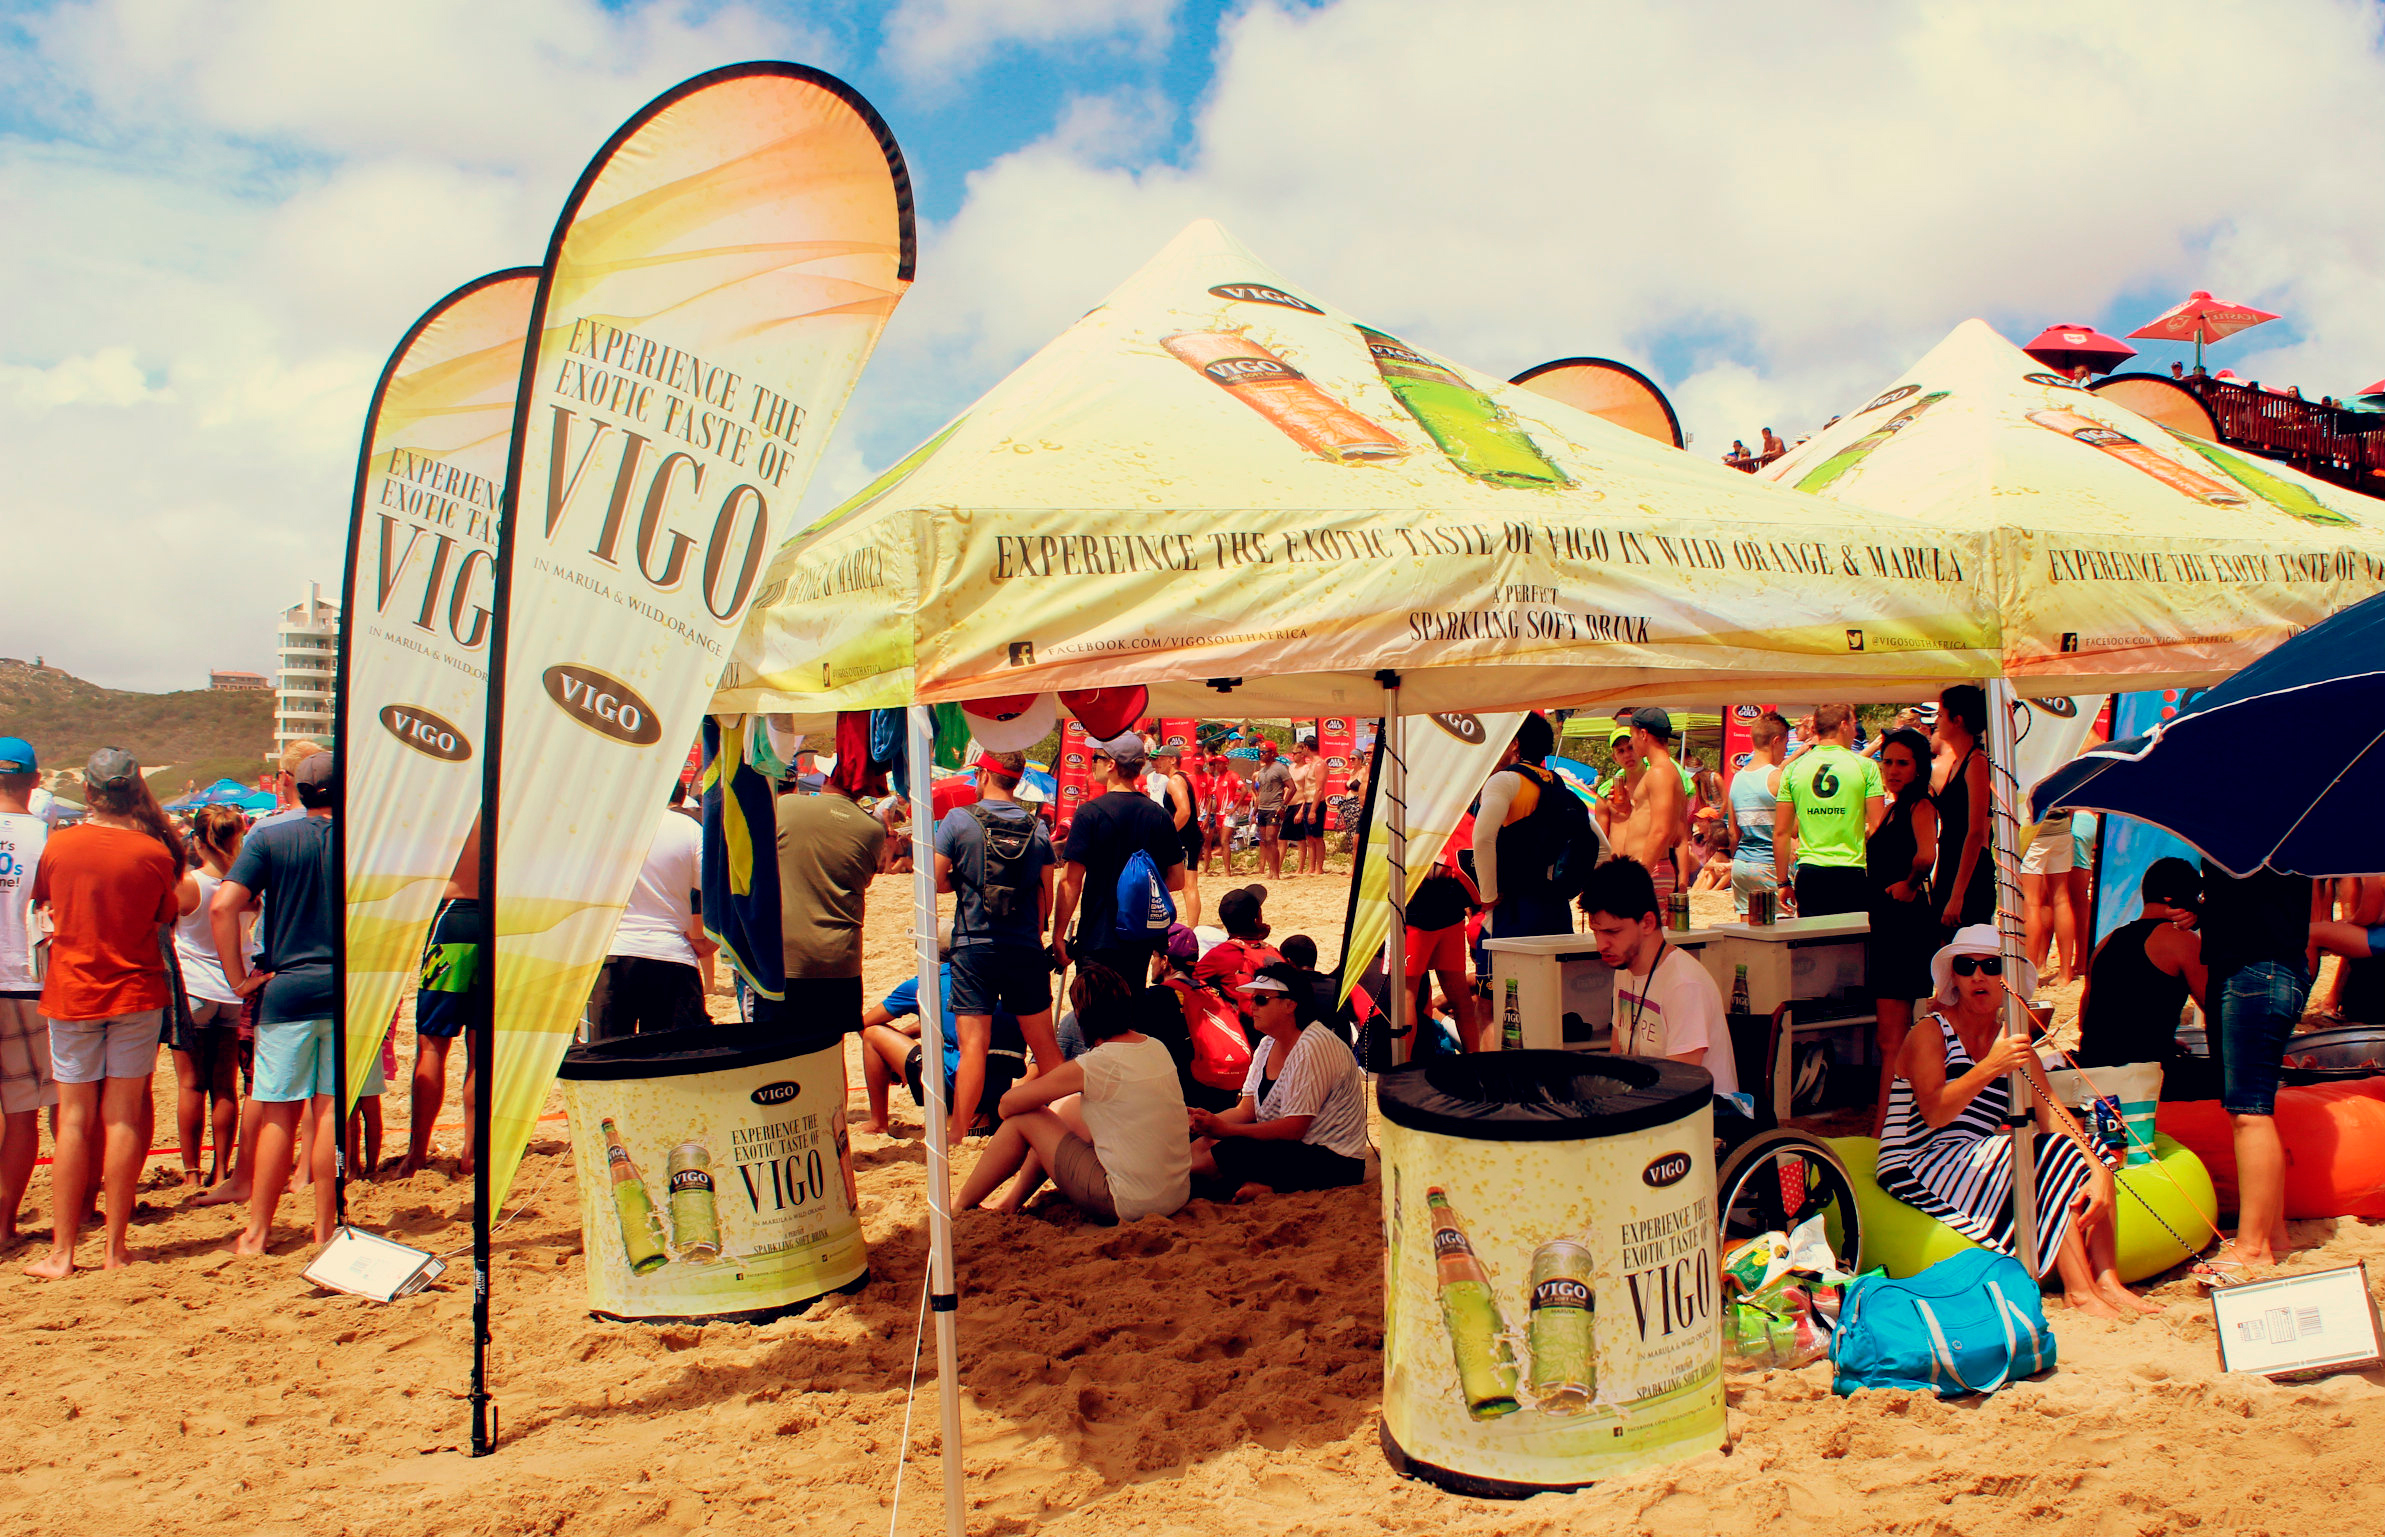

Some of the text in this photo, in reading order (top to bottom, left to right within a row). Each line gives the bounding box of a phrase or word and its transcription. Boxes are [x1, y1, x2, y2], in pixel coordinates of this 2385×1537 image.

[1220, 287, 1308, 310] VIGO
[567, 316, 807, 448] EXPERIENCE THE
[1206, 360, 1284, 379] VIGO
[554, 358, 796, 489] EXOTIC TASTE OF
[378, 477, 461, 530] EXOTIC
[545, 404, 771, 624] VIGO
[994, 519, 1965, 582] EXPEREINCE THE EXOTIC TASTE OF VIGO IN WILD ORANGE & MARULA
[2047, 549, 2168, 583] EXPEREINCE
[2167, 553, 2211, 583] THE
[2209, 554, 2276, 583] EXOTIC
[2275, 552, 2330, 583] TASTE
[2335, 550, 2356, 582] OF
[533, 556, 551, 572] IN
[553, 565, 611, 600] MARULA
[613, 591, 624, 606] &
[628, 595, 664, 624] WILD
[1492, 583, 1559, 606] A PERFECT
[1047, 627, 1309, 656] FACEBOOK.COM/VIGOSOUTHAFRICA
[1408, 609, 1653, 644] SPARKLING SOFT DRINK
[1871, 635, 1968, 650] @VIGOSOUTHAFRICA
[369, 625, 383, 638] IN
[384, 630, 431, 658] MARULA
[432, 650, 441, 662] &
[443, 654, 472, 675] WILD
[560, 671, 643, 733] VIGO
[1737, 709, 1758, 717] GOLD
[391, 709, 458, 754] VIGO
[1812, 763, 1840, 799] 6
[1807, 807, 1846, 815] HANDRE
[1503, 1011, 1521, 1023] VIGO
[758, 1085, 794, 1102] VIGO
[731, 1112, 819, 1146] EXPERIENCE THE
[734, 1141, 776, 1162] EXOTIC
[779, 1132, 809, 1155] TASTE
[810, 1129, 820, 1146] OF
[673, 1171, 709, 1186] VIGO
[737, 1149, 825, 1216] VIGO
[1649, 1157, 1685, 1183] VIGO
[1621, 1195, 1707, 1246] EXPERIENCE THE
[753, 1240, 794, 1256] SPARKLING
[1434, 1232, 1467, 1249] VIGO
[1622, 1238, 1666, 1270] EXOTIC
[1668, 1225, 1699, 1257] TASTE
[1537, 1281, 1587, 1300] VIGO
[1624, 1248, 1711, 1344] VIGO
[1637, 1353, 1646, 1361] IN
[1647, 1344, 1675, 1360] MARULA
[1636, 1376, 1682, 1400] SPARKLING
[1682, 1367, 1700, 1387] SOFT
